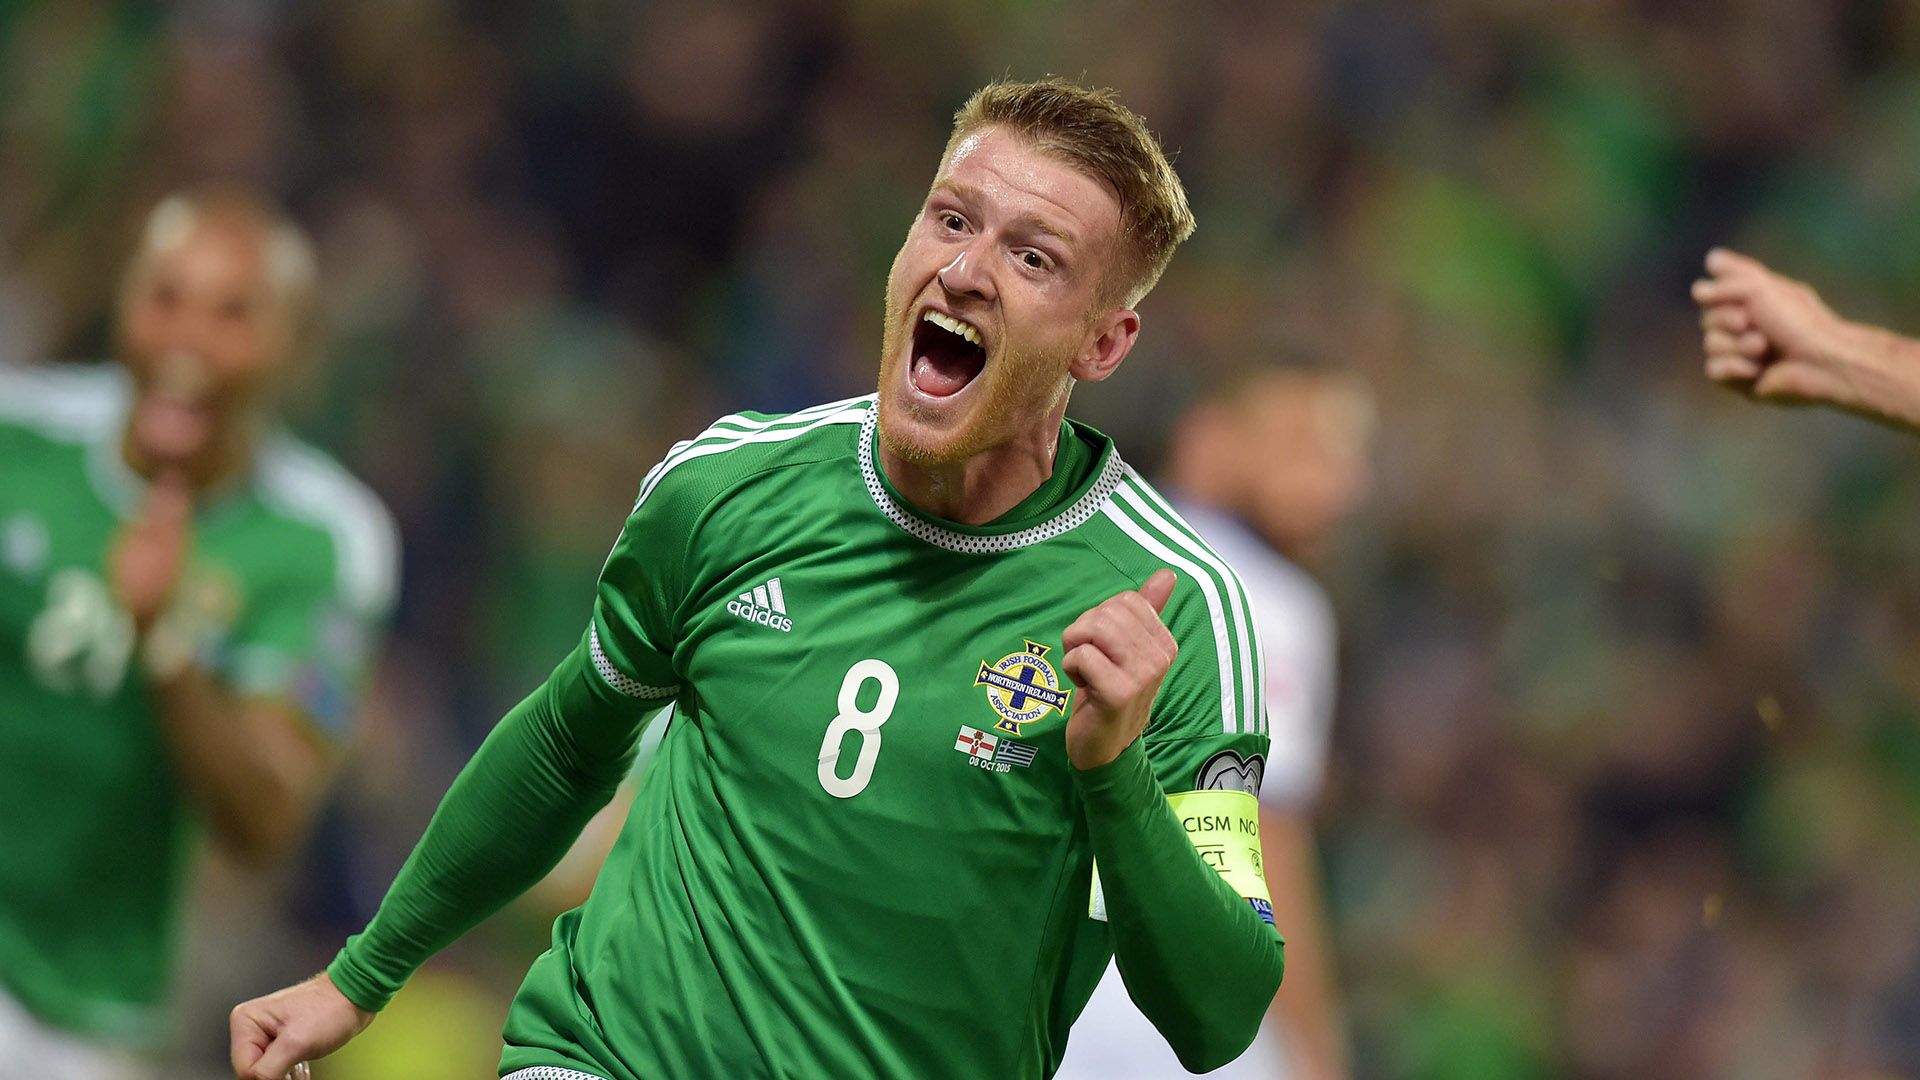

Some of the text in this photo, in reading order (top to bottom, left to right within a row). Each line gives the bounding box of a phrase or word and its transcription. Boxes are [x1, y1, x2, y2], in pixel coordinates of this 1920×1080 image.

[726, 599, 793, 633] adidas
[998, 655, 1055, 687] IRISH FOOTBALL
[987, 672, 1057, 703] NORTHERN IRELAND
[990, 694, 1042, 721] ASSOCIATION
[817, 658, 900, 799] 8
[968, 756, 1011, 773] 08 OCT 2015
[1182, 815, 1260, 836] CISM NO
